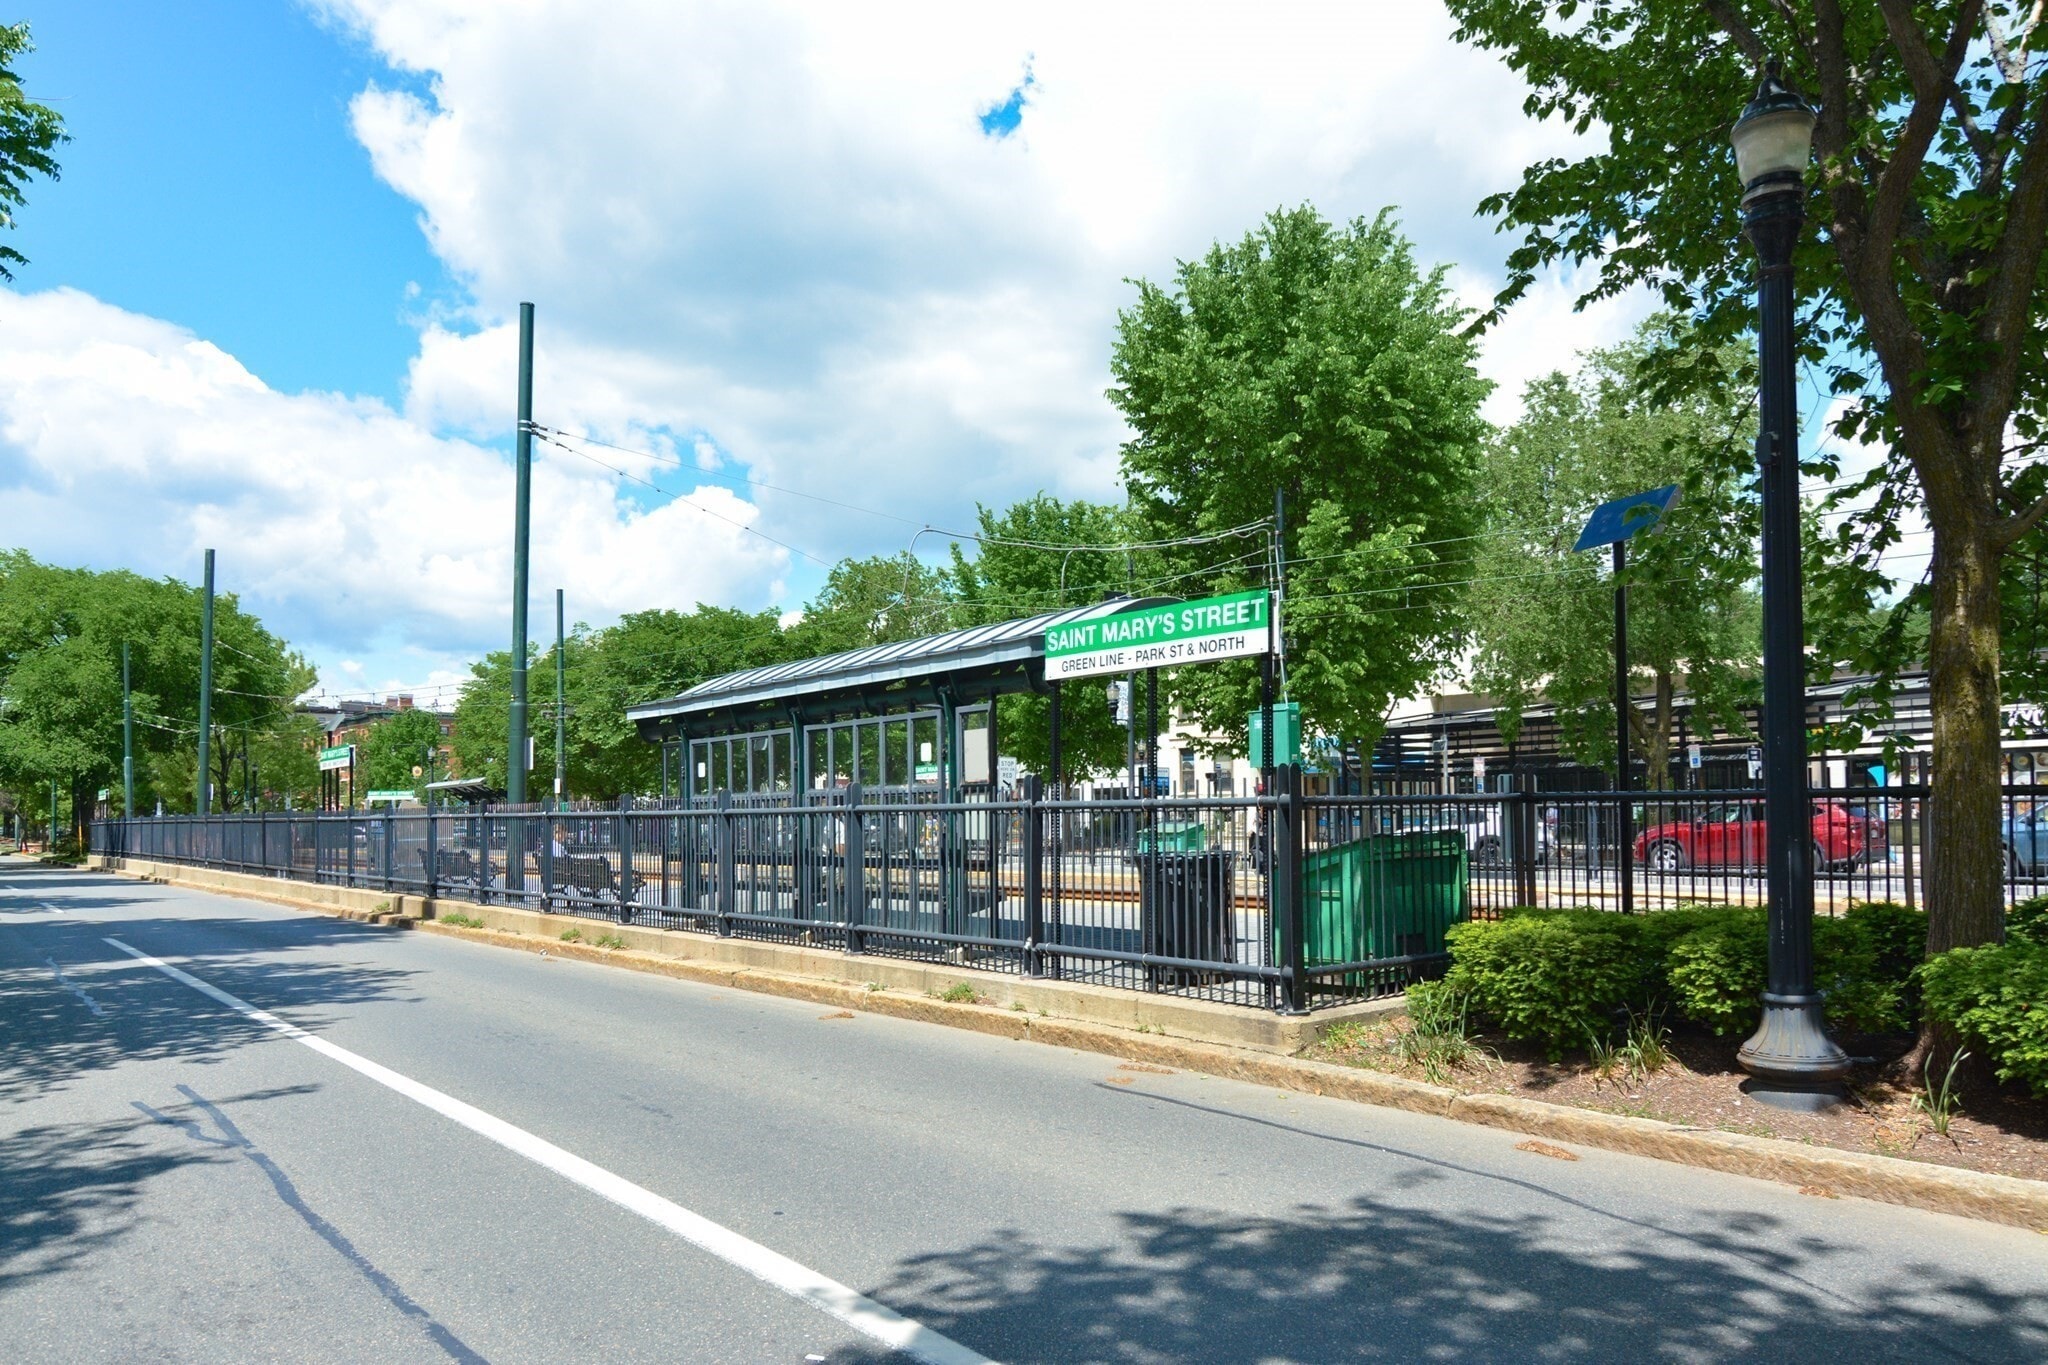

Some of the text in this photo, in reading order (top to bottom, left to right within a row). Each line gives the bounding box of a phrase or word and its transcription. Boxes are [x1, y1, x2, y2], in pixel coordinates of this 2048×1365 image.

[1048, 598, 1265, 651] SAINT MARY'S STREET
[1062, 656, 1096, 673] GREEN
[1100, 652, 1124, 668] LINE
[1135, 647, 1165, 662] PARK
[1170, 643, 1183, 658] ST
[1187, 642, 1195, 656] &
[1199, 636, 1245, 654] NORTH
